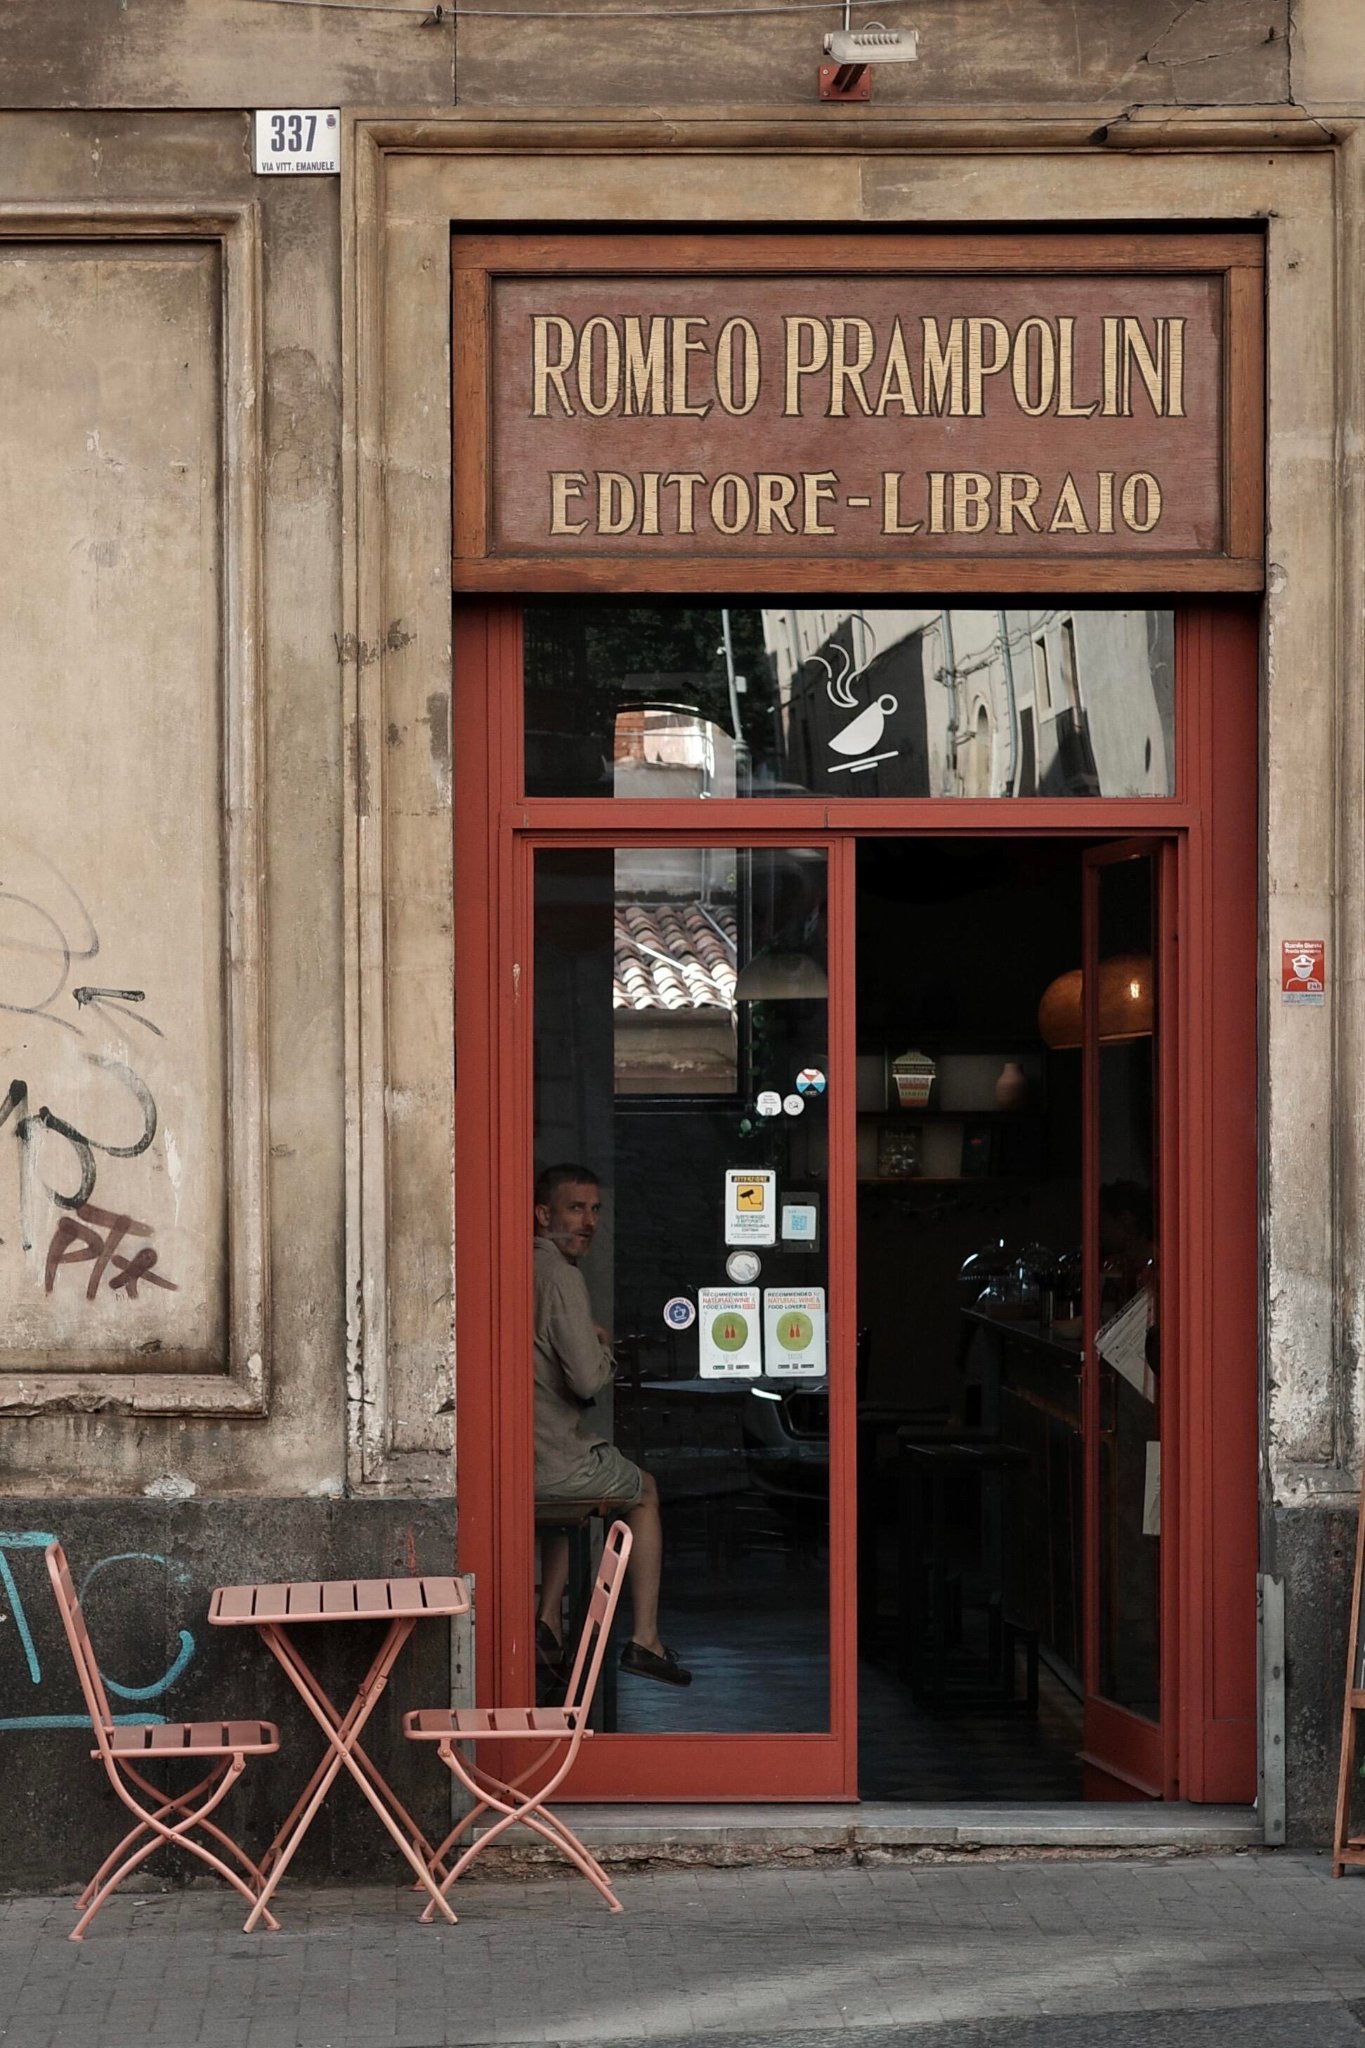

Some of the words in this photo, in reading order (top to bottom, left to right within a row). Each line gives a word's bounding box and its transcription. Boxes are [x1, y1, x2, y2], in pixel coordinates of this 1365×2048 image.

[270, 114, 317, 153] 337
[261, 162, 274, 171] VIA
[276, 162, 294, 171] VITT.
[296, 161, 335, 171] EMANUELE
[528, 313, 762, 419] ROMEO
[782, 313, 1189, 419] PRAMPOLINI
